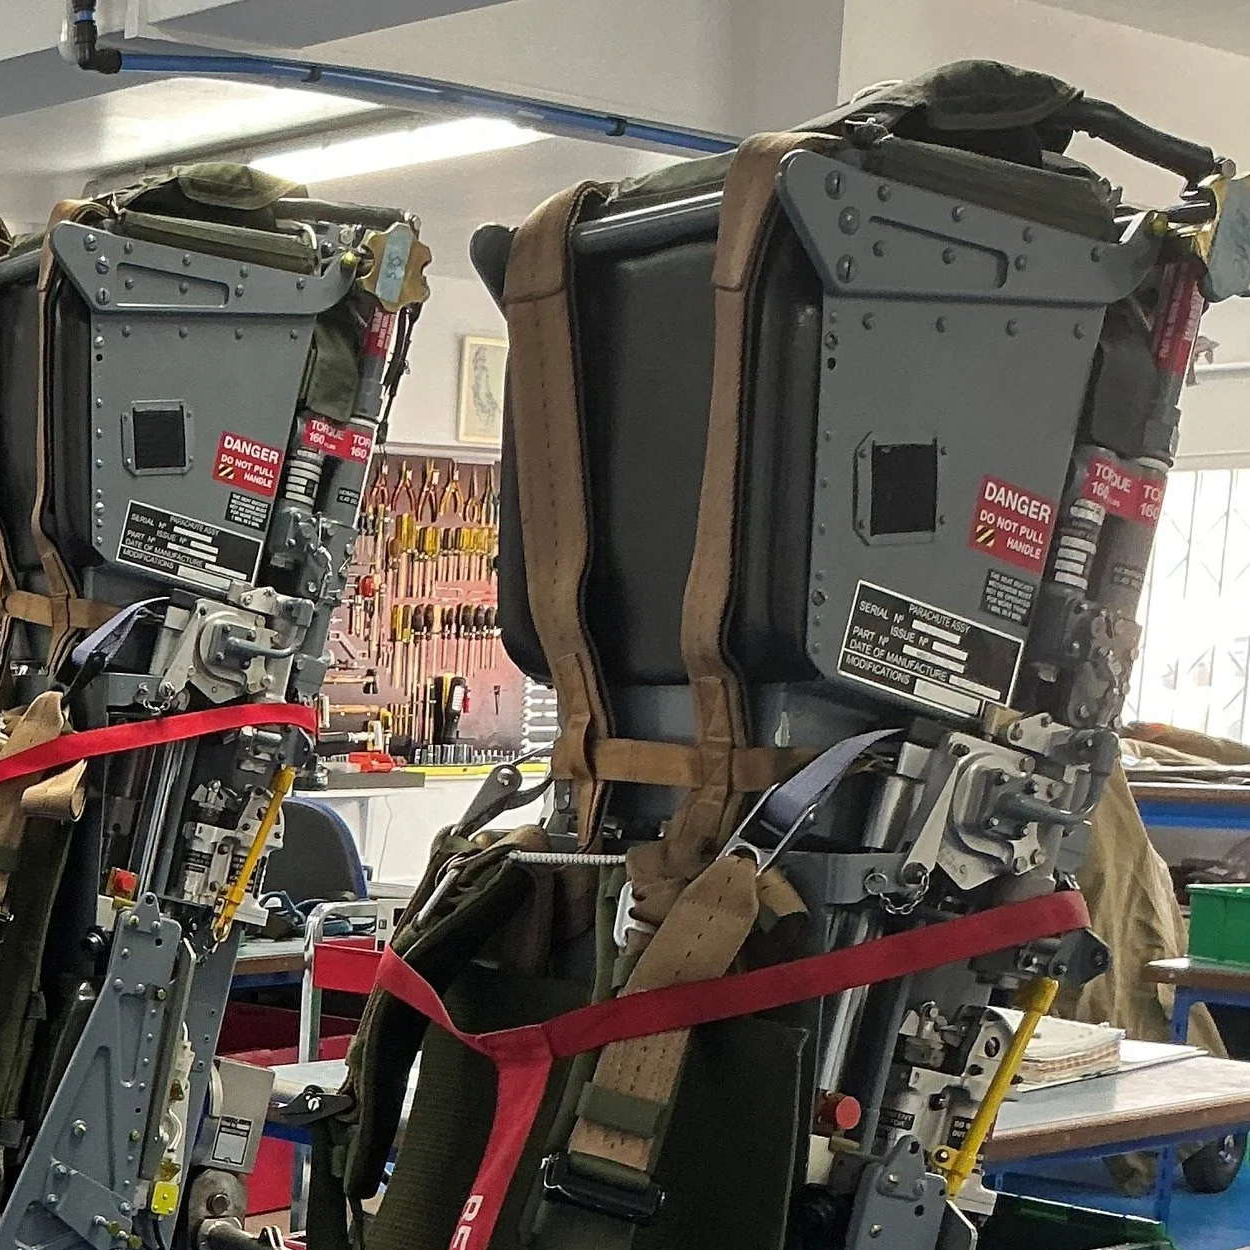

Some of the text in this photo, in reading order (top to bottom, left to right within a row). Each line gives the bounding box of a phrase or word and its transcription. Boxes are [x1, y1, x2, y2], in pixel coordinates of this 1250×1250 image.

[309, 431, 325, 445] 160
[224, 435, 279, 465] DANGER
[221, 454, 275, 479] DO NOT PULL
[243, 472, 273, 488] HANDLE
[984, 481, 1052, 524] DANGER
[130, 513, 155, 527] SERIAL
[979, 509, 1044, 545] DO NOT PULL
[125, 538, 143, 549] DATE
[127, 529, 145, 540] PART
[1006, 536, 1042, 560] HANDLE
[859, 600, 889, 620] SERIAL
[908, 603, 972, 634] PARACHUTE ASSY
[852, 625, 876, 641] PART
[890, 626, 916, 643] ISSUE
[846, 654, 911, 685] MODIFICATIONS
[850, 639, 871, 656] DATE
[872, 645, 886, 658] OF
[886, 651, 948, 682] MANUFACTURE
